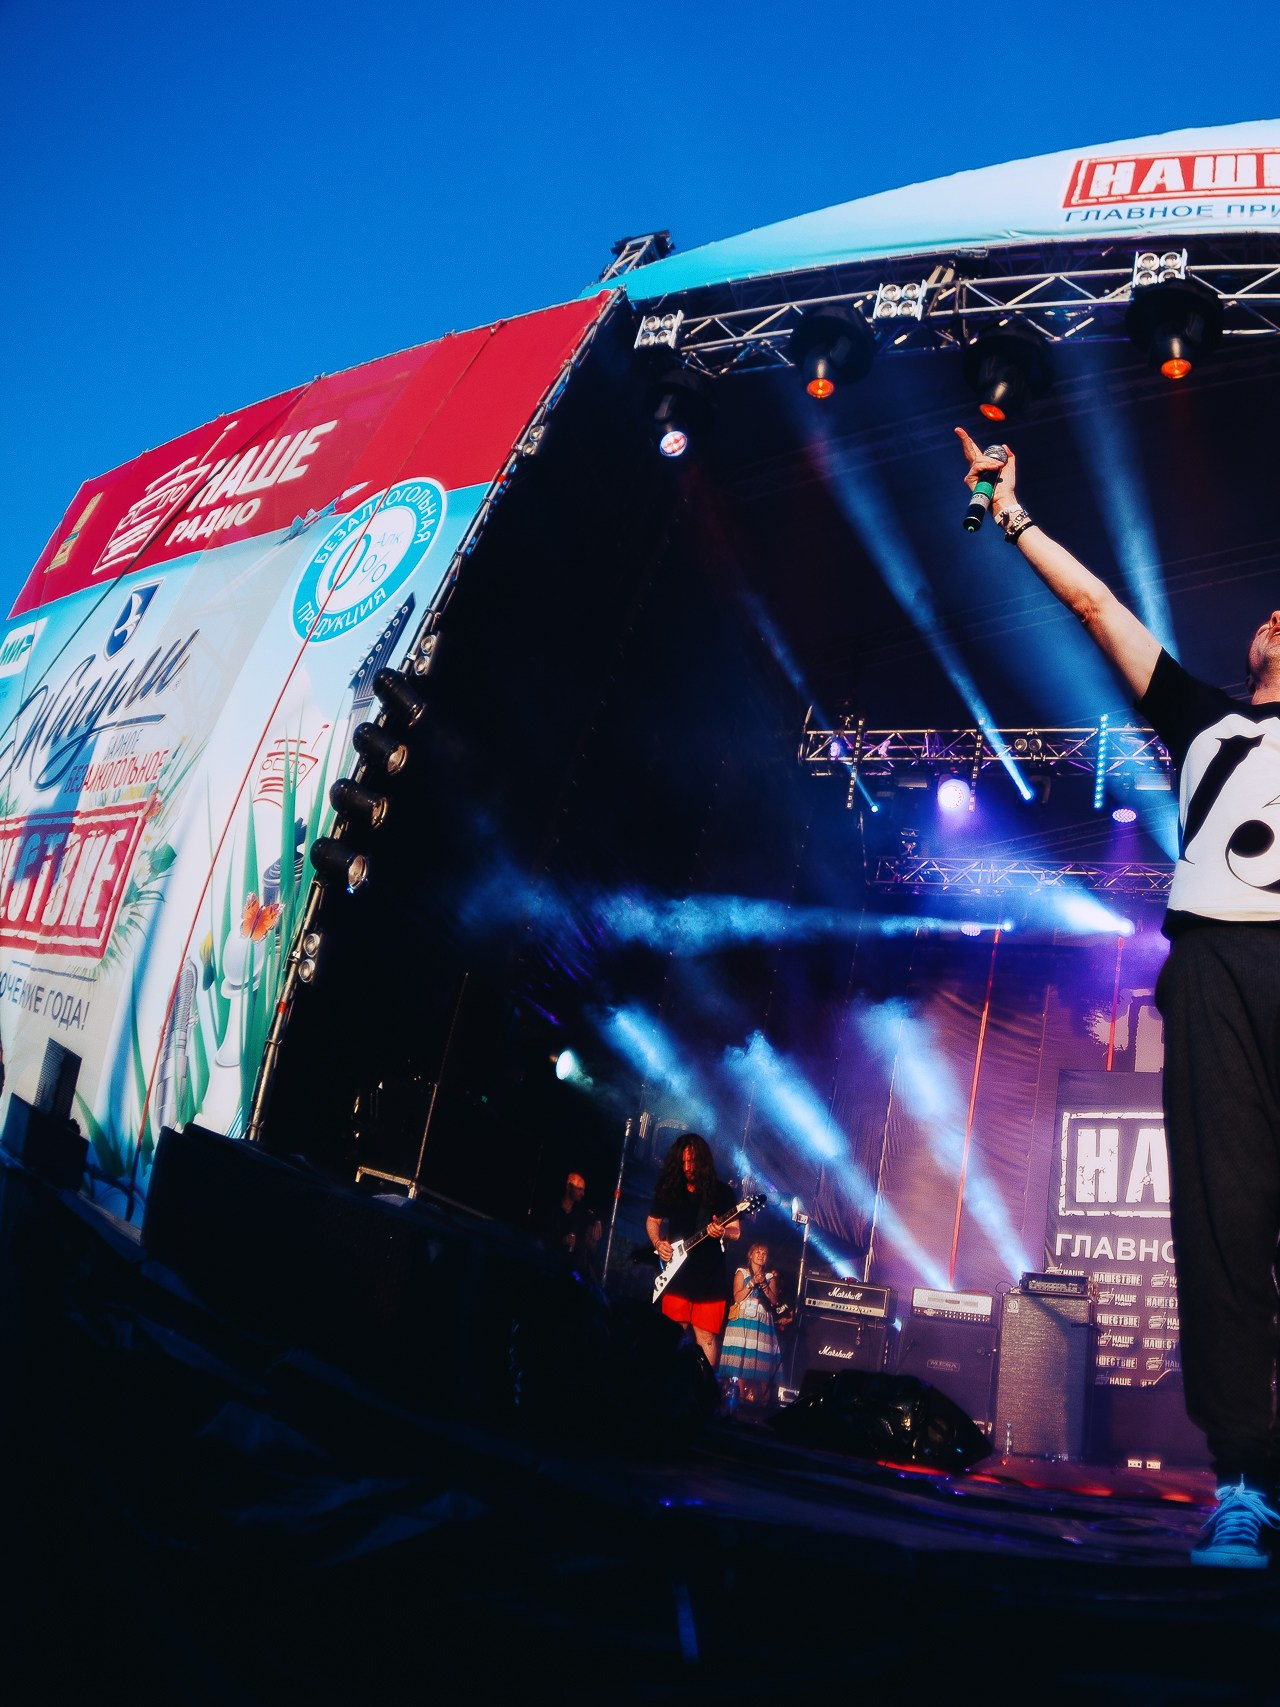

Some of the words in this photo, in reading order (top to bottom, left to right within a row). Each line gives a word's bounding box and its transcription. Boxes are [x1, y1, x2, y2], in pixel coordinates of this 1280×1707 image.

[1065, 204, 1215, 223] ГЛАВНОЕ
[187, 420, 338, 512] НАШЕ
[165, 498, 261, 546] РАДИО
[314, 486, 437, 564] БЕЗАЛКОГОЛЬНАЯ
[297, 587, 387, 639] ПРОДУКЦИЯ
[63, 749, 169, 794] БЕЗАЛКОГОЛЬНОЕ
[0, 829, 128, 927] ЕСТВИЕ
[43, 990, 90, 1031] ГОДА!
[1055, 1233, 1176, 1264] ГЛАВНО
[1094, 1273, 1141, 1286] НАШЕСТВИЕ
[828, 1287, 863, 1300] Marshall
[1114, 1293, 1137, 1303] НАШЕ
[1146, 1298, 1178, 1309] НАШЕСТ
[1096, 1315, 1139, 1327] АШЕСТВИЕ
[818, 1346, 854, 1359] Marshall
[1112, 1336, 1135, 1345] НАШЕ
[1144, 1339, 1177, 1350] НАШЕСТ
[1098, 1355, 1136, 1368] ШЕСТВИЕ
[1109, 1378, 1132, 1386] НАШЕ
